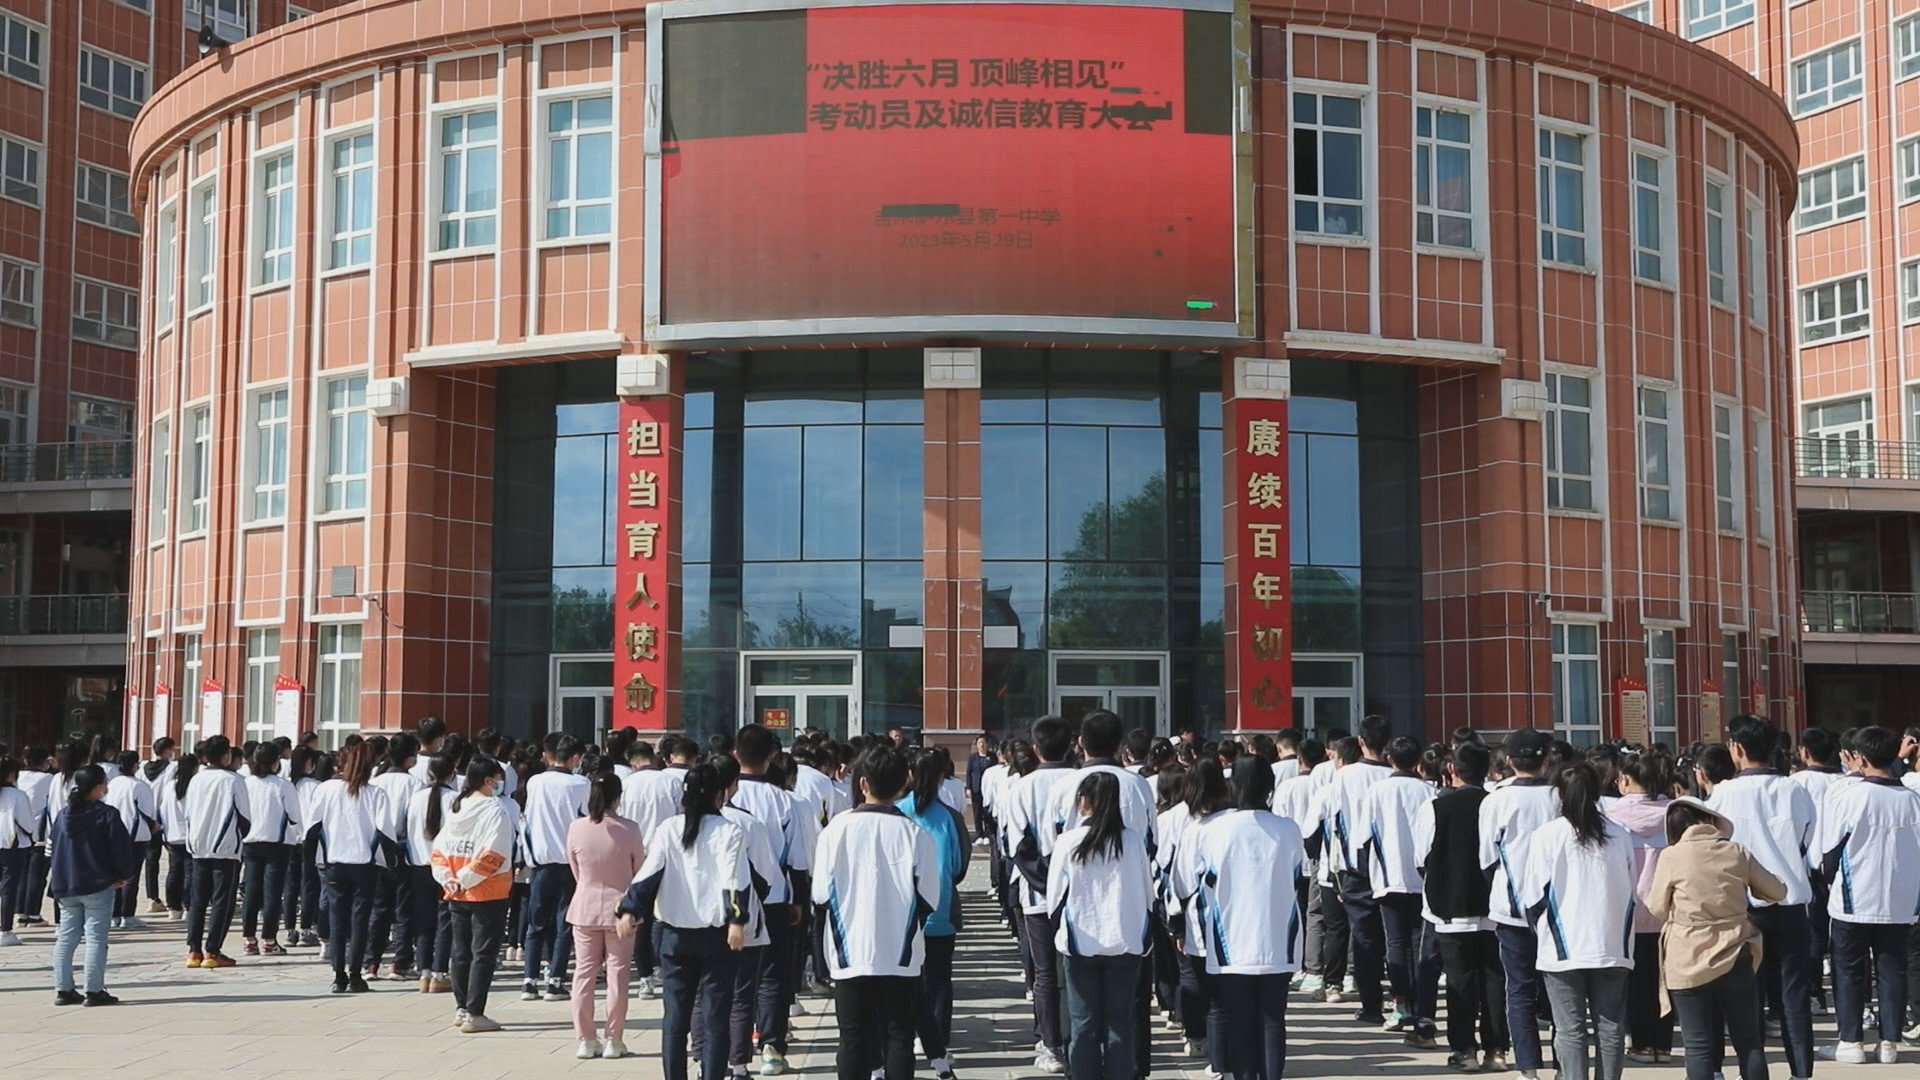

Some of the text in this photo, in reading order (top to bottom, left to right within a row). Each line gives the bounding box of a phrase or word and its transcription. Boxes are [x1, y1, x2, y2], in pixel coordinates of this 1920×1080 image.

[624, 419, 660, 712] 担当育人使命
[1247, 418, 1283, 712] 赓续百年初心
